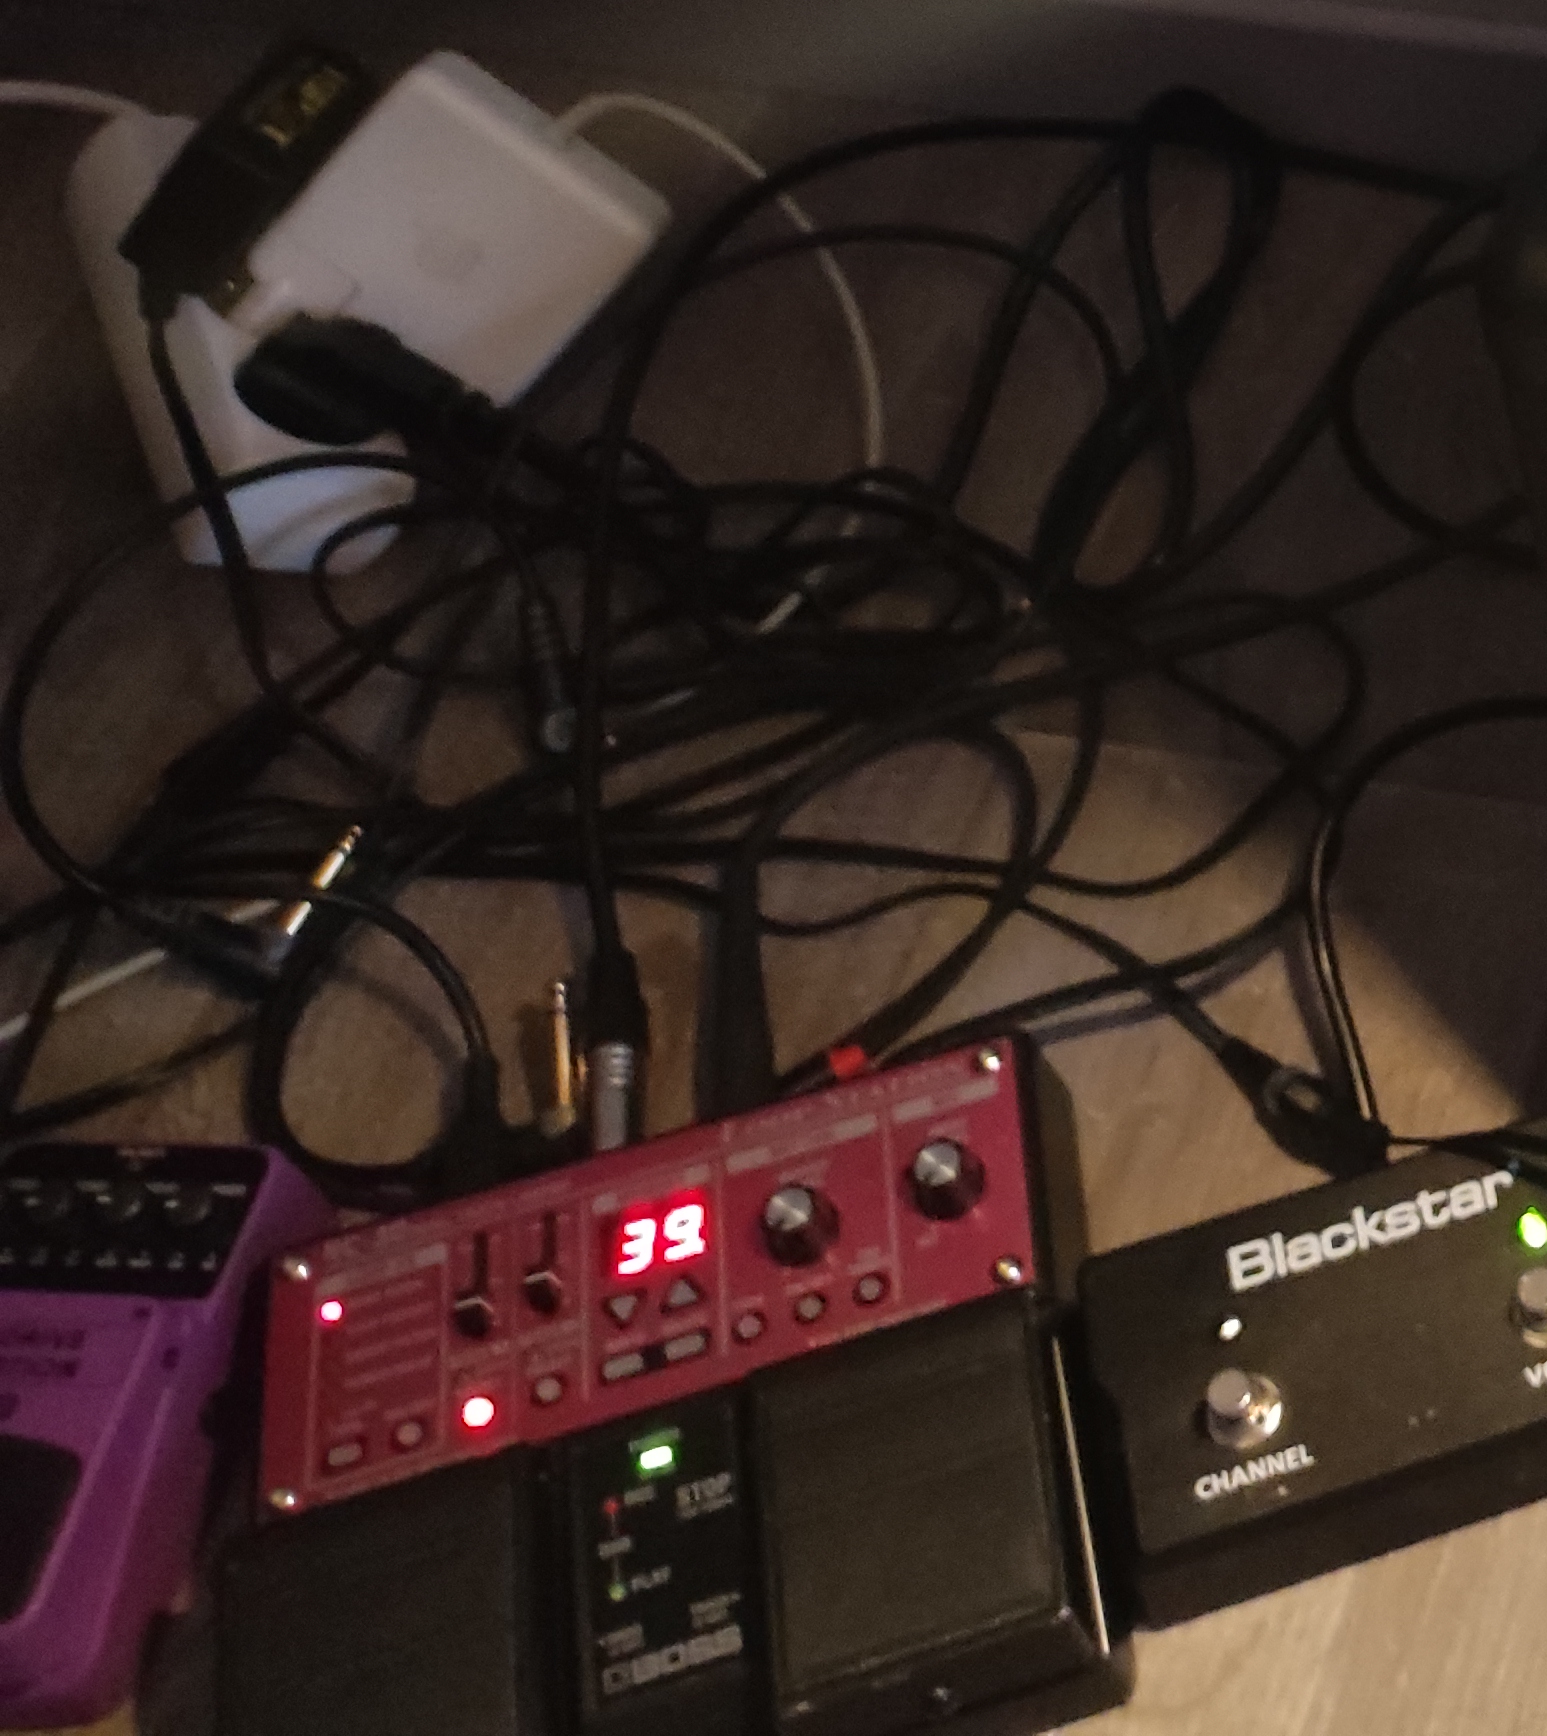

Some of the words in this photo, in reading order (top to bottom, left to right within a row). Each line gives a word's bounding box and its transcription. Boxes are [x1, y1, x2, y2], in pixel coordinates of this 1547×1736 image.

[616, 1202, 706, 1276] 39
[1225, 1169, 1515, 1292] Blackstar
[1194, 1442, 1316, 1502] CHANNEL
